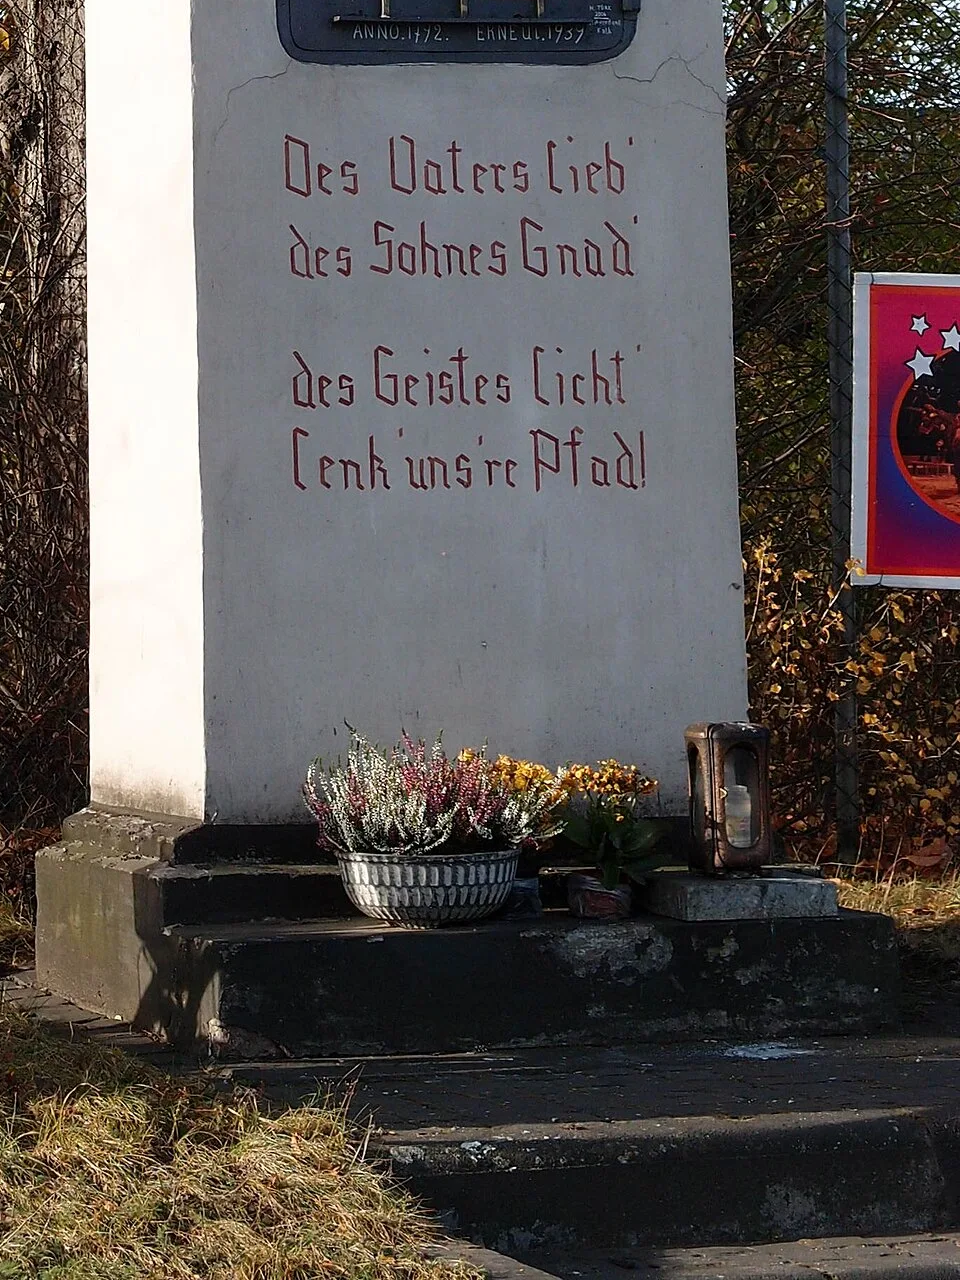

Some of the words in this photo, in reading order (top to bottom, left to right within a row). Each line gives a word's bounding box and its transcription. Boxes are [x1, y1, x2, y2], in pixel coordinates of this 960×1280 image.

[284, 134, 359, 198] Des
[389, 134, 529, 195] Vaters
[289, 223, 352, 279] des
[370, 220, 507, 277] Sohnes
[292, 351, 355, 409] des
[374, 345, 511, 407] Geistes
[529, 426, 647, 493] Pfad!
